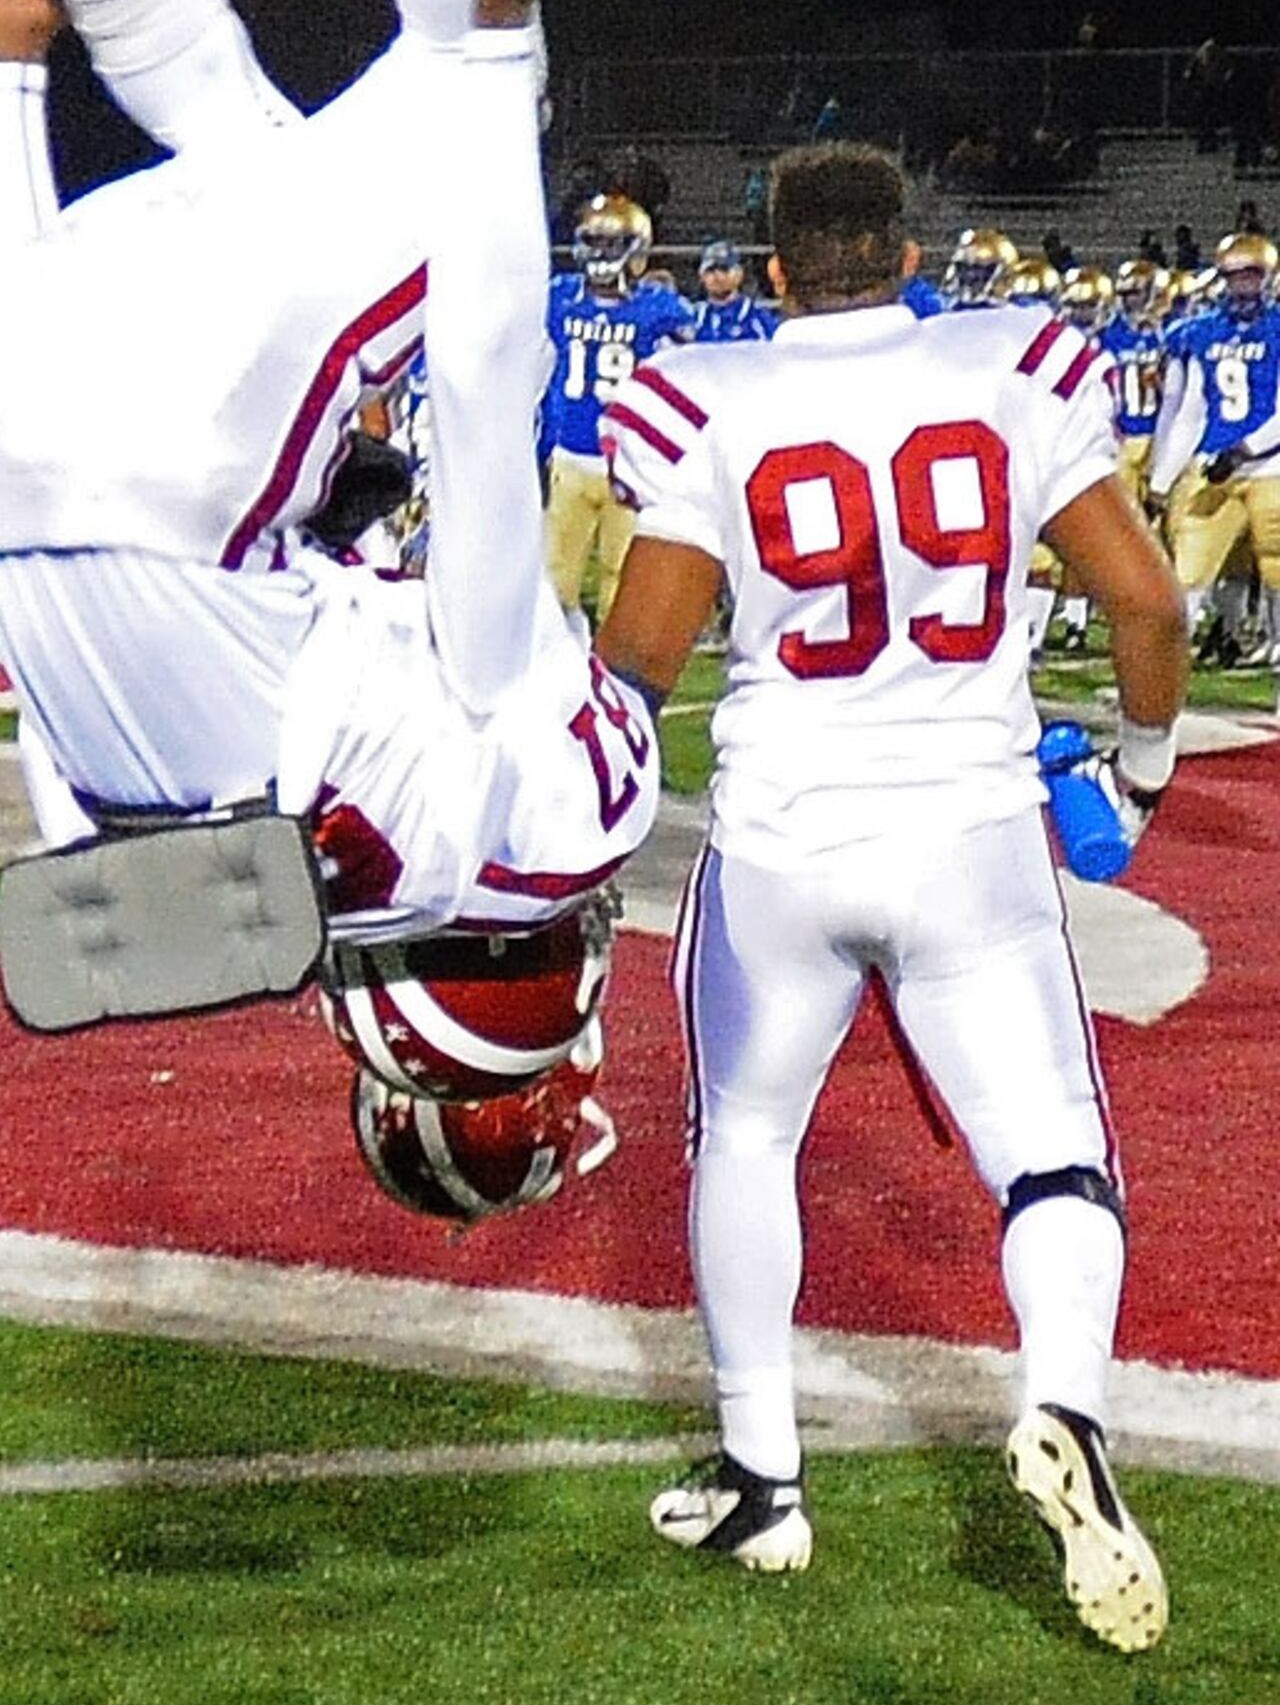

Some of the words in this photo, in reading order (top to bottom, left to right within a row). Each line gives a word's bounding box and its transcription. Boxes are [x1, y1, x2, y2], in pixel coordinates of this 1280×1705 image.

[563, 338, 635, 403] 19
[1215, 358, 1251, 423] 9
[745, 417, 1012, 680] 99
